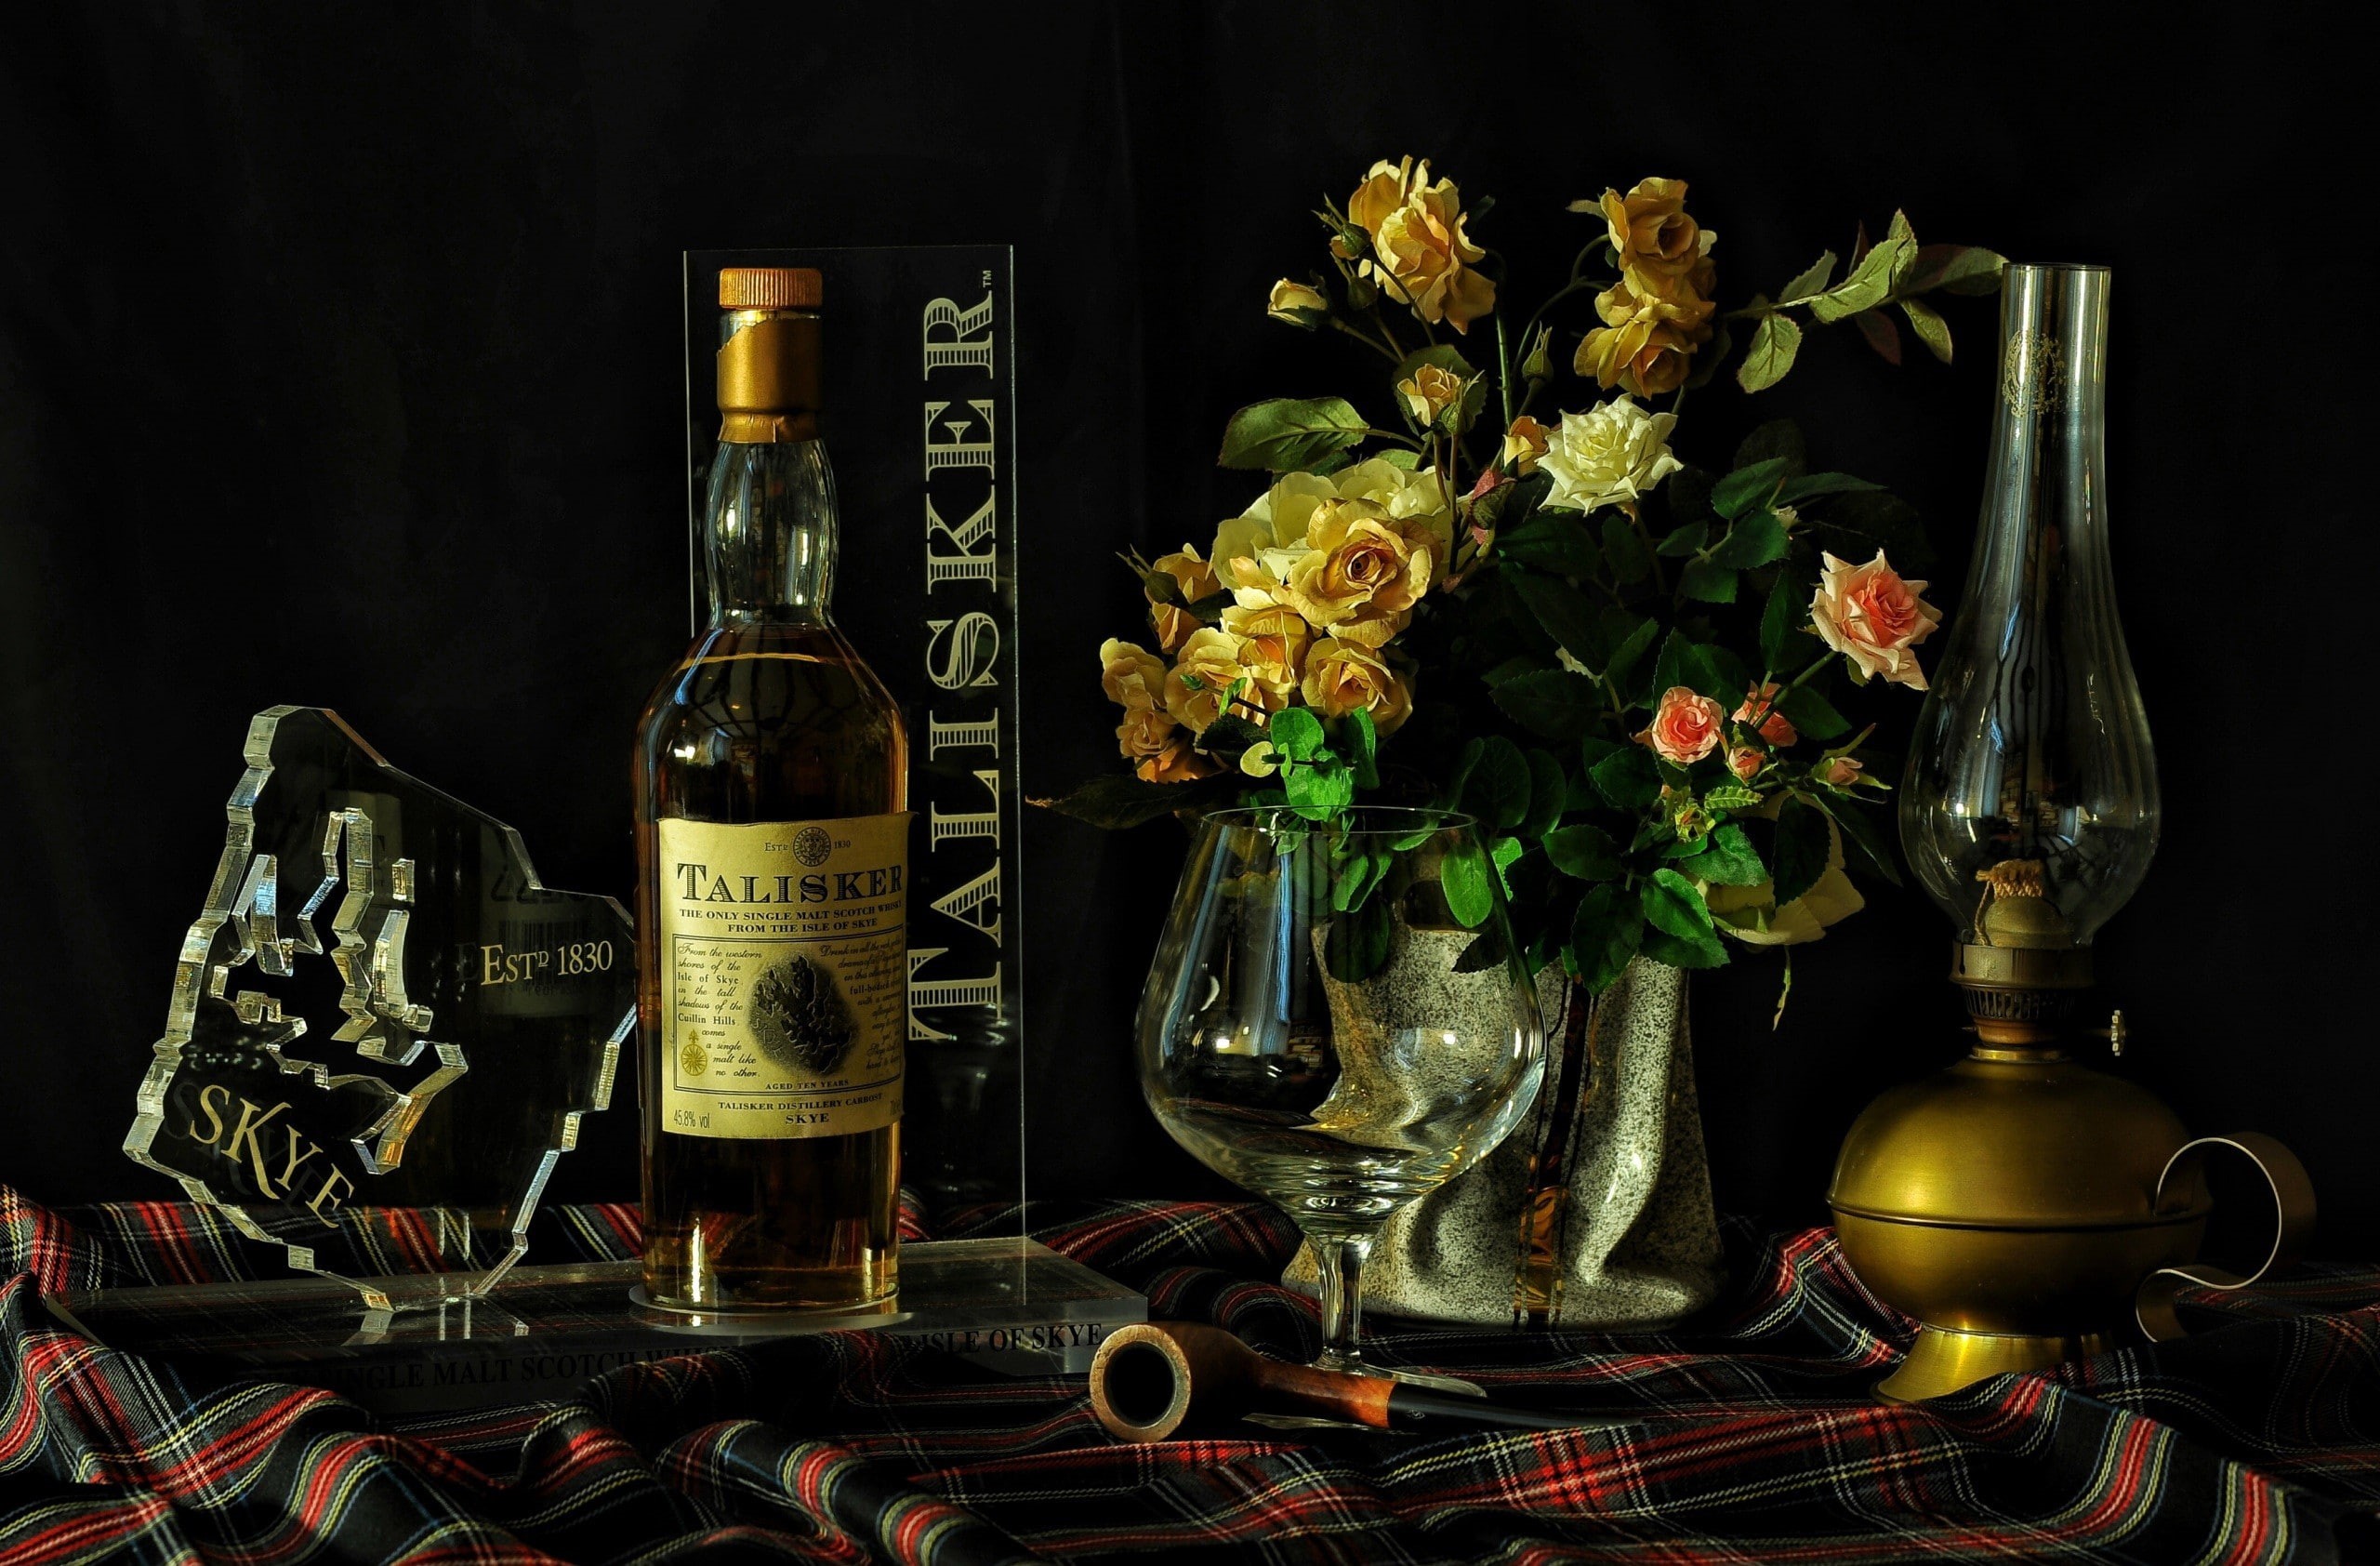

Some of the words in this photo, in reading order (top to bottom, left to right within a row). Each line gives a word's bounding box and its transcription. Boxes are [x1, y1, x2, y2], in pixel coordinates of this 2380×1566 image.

[907, 290, 999, 1042] TALISKER
[834, 840, 851, 849] 1830
[678, 863, 902, 904] TALISKER
[680, 909, 703, 919] THE
[707, 910, 739, 921] ONLY
[744, 911, 792, 921] SINGLE
[796, 910, 829, 921] MALT
[833, 906, 875, 919] SCOTCH
[728, 923, 765, 934] FROM
[770, 923, 798, 934] THE
[802, 922, 829, 933] ISLE
[833, 921, 850, 931] OF
[852, 918, 878, 929] SKYE
[557, 939, 614, 976] 1830
[678, 942, 706, 956] From
[709, 947, 722, 957] the
[725, 949, 762, 959] western
[678, 958, 705, 969] shores
[711, 960, 723, 974] of
[727, 961, 741, 971] the
[678, 972, 692, 981] Isle
[699, 975, 708, 983] of
[694, 986, 707, 995] the
[717, 986, 737, 997] tall
[678, 997, 709, 1009] shadows
[715, 999, 728, 1014] of
[730, 1001, 743, 1011] the
[678, 1013, 707, 1024] Cuillin
[716, 1041, 742, 1055] single
[713, 1053, 735, 1064] malt
[738, 1053, 757, 1064] like
[820, 1080, 849, 1088] YEARS
[718, 1101, 774, 1110] TALISKER
[777, 1099, 843, 1111] DISTILLERY
[845, 1093, 883, 1107] CARBOST
[699, 1112, 710, 1129] vol
[786, 1112, 830, 1125] SKYE
[189, 1083, 356, 1229] SKYE
[988, 1328, 1025, 1352] OF
[1032, 1322, 1103, 1349] SKYE
[431, 1360, 513, 1386] MALT
[521, 1351, 635, 1382] SCOTCH
